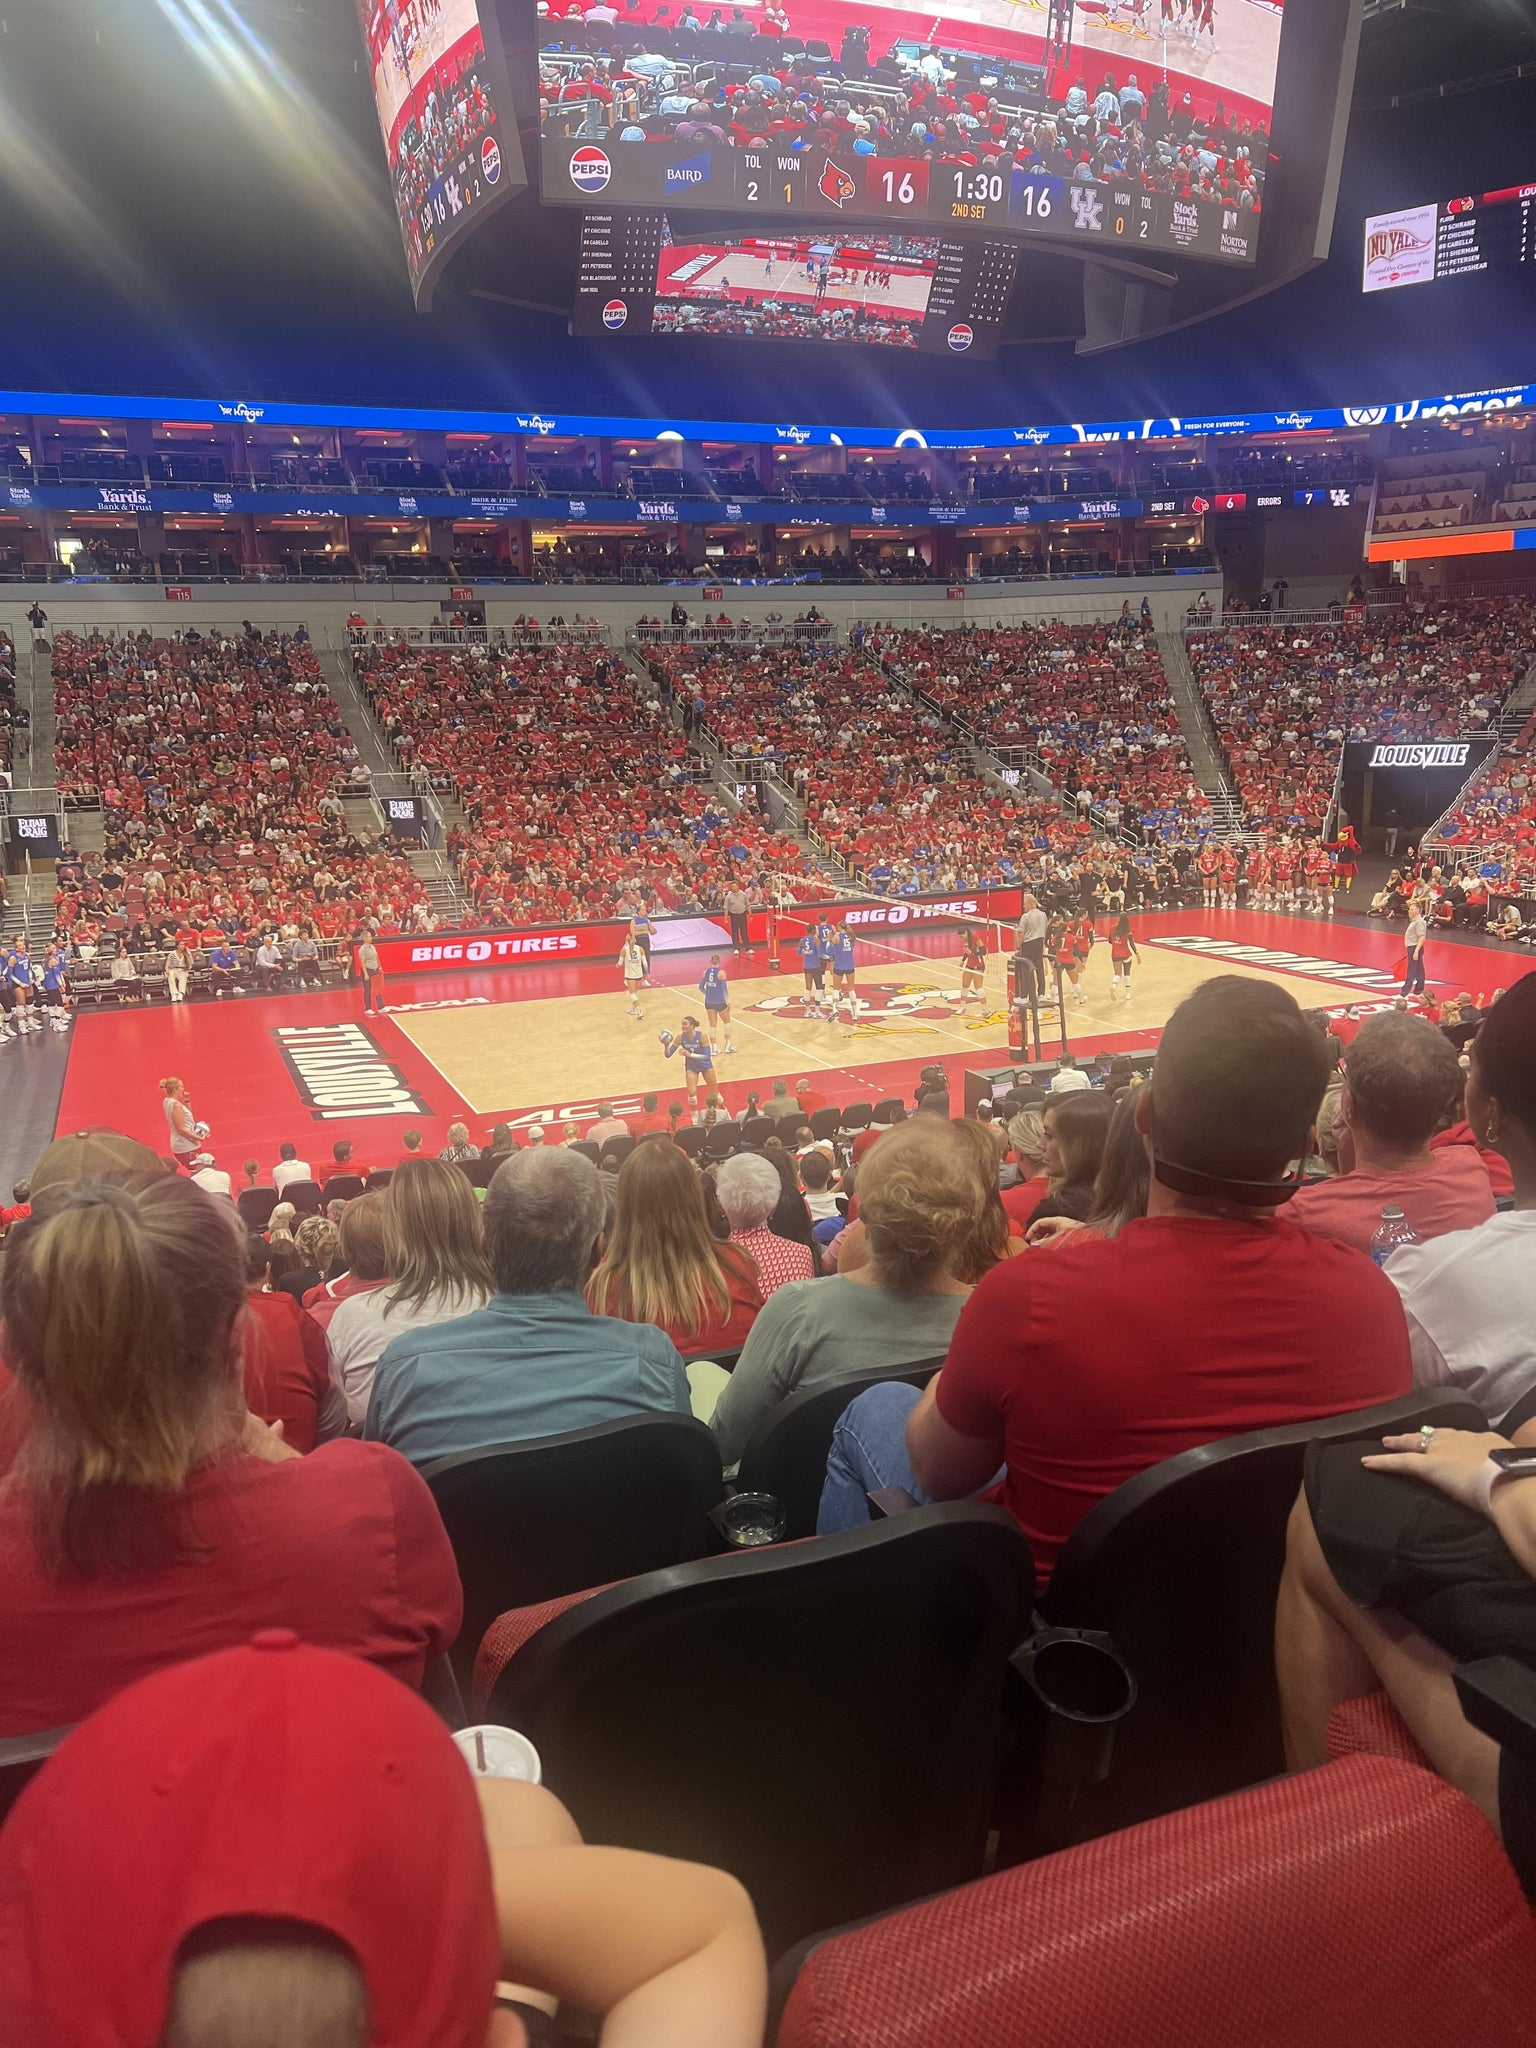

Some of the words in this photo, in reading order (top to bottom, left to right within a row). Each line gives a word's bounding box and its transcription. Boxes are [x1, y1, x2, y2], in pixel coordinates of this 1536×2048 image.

[483, 152, 499, 169] PEPSI
[745, 154, 762, 169] TOL
[777, 156, 800, 172] WON
[572, 163, 611, 177] PEPSI
[667, 168, 702, 182] BAIRD
[474, 179, 481, 198] 2
[747, 182, 759, 201] 2
[784, 184, 792, 203] 1
[882, 171, 915, 204] 16
[953, 171, 1003, 202] 1:30
[465, 187, 472, 205] 0
[1023, 186, 1051, 217] 16
[1114, 192, 1131, 206] WON
[1141, 196, 1152, 210] TOL
[434, 193, 446, 224] 16
[951, 203, 970, 218] 2ND
[972, 204, 986, 219] SET
[1173, 201, 1199, 217] Stock
[1115, 216, 1125, 235] 0
[1139, 220, 1148, 238] 2
[1221, 233, 1248, 248] NORTON
[1371, 234, 1388, 259] NU
[1389, 231, 1419, 255] YALE
[1450, 246, 1479, 257] SHERMAN
[1449, 262, 1488, 275] BLACKSHEAR
[604, 310, 626, 318] PEPSI
[949, 333, 972, 342] PEPSI
[234, 404, 264, 423] Kroger
[1286, 413, 1313, 429] Kroger
[529, 416, 556, 434] Kroger
[1215, 420, 1245, 428] EVERYONE
[787, 427, 811, 444] Kroger
[1025, 429, 1050, 445] Kroger
[1226, 497, 1234, 508] 6
[1257, 497, 1282, 506] ERRORS
[1305, 493, 1313, 504] 7
[97, 502, 120, 511] Bank
[121, 503, 128, 511] &
[129, 503, 152, 512] Trust
[1151, 502, 1163, 512] 2ND
[1164, 502, 1175, 511] SET
[176, 591, 190, 601] 115
[460, 591, 472, 600] 116
[711, 591, 721, 600] 117
[1368, 743, 1471, 769] LOUISVILLE
[389, 800, 414, 809] ELIJAH
[389, 808, 415, 818] CRAIG
[17, 818, 47, 828] ELIJAH
[18, 826, 48, 838] CRAIG
[845, 908, 886, 924] BIG
[888, 906, 909, 924] O
[910, 900, 977, 919] TIRES
[411, 944, 463, 962] BIG
[466, 941, 492, 961] O
[494, 935, 577, 955] TIRES
[805, 941, 810, 950] 5
[843, 938, 851, 947] 15
[630, 951, 638, 960] 12
[708, 972, 714, 982] 6
[385, 997, 491, 1013] NCAA
[277, 1023, 422, 1119] LOUISVILLE
[506, 1097, 643, 1127] ACC
